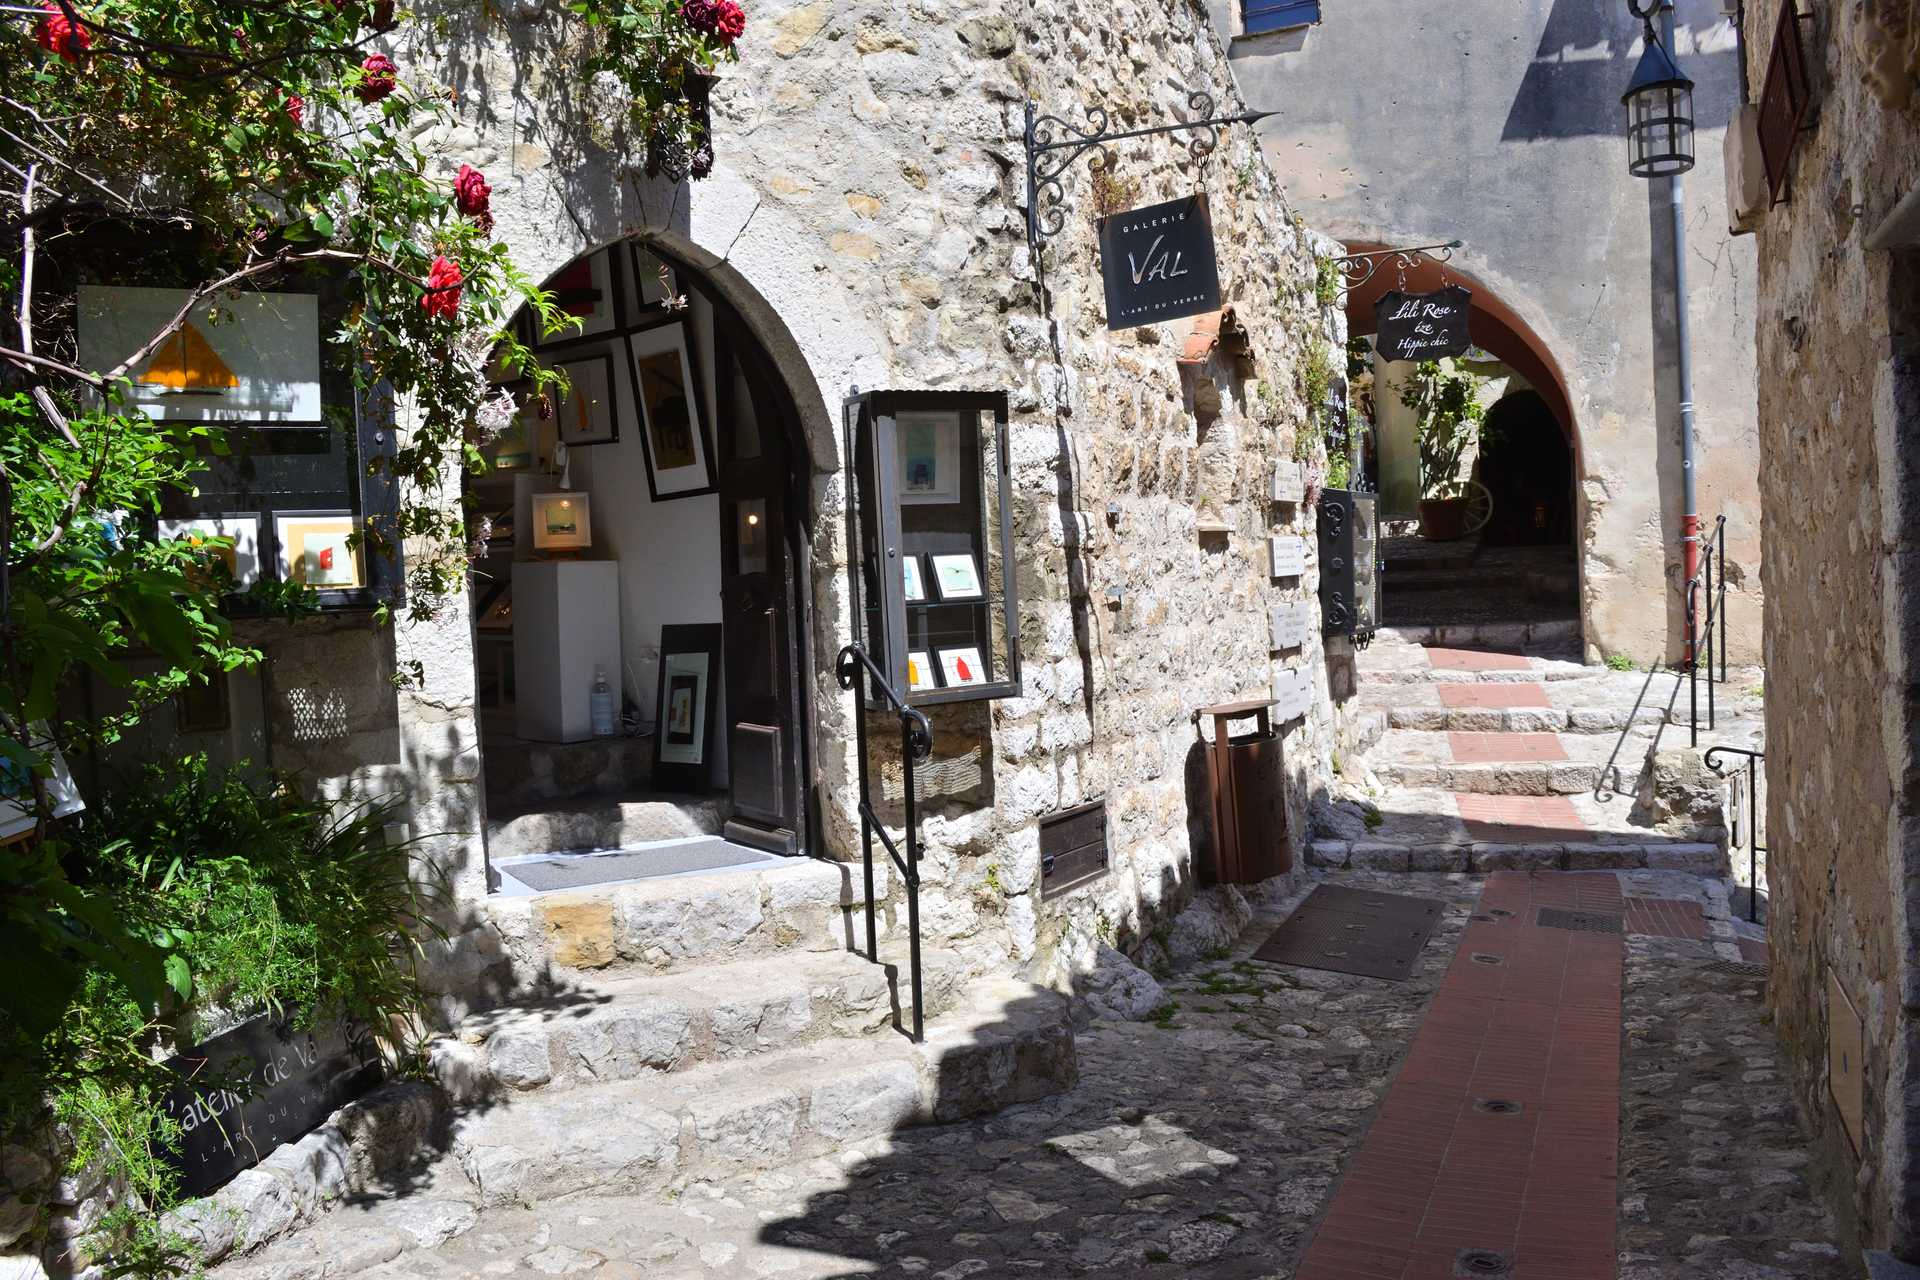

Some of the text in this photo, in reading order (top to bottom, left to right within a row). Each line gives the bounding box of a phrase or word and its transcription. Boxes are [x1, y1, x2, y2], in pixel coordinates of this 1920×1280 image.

[1123, 213, 1185, 233] GALERIE
[1128, 234, 1188, 285] VAL
[1155, 302, 1167, 310] DU
[1173, 294, 1205, 306] VERRE
[1388, 299, 1420, 321] Lili
[1397, 329, 1449, 359] Hippie chic
[264, 1047, 291, 1087] de
[268, 1107, 288, 1124] DU
